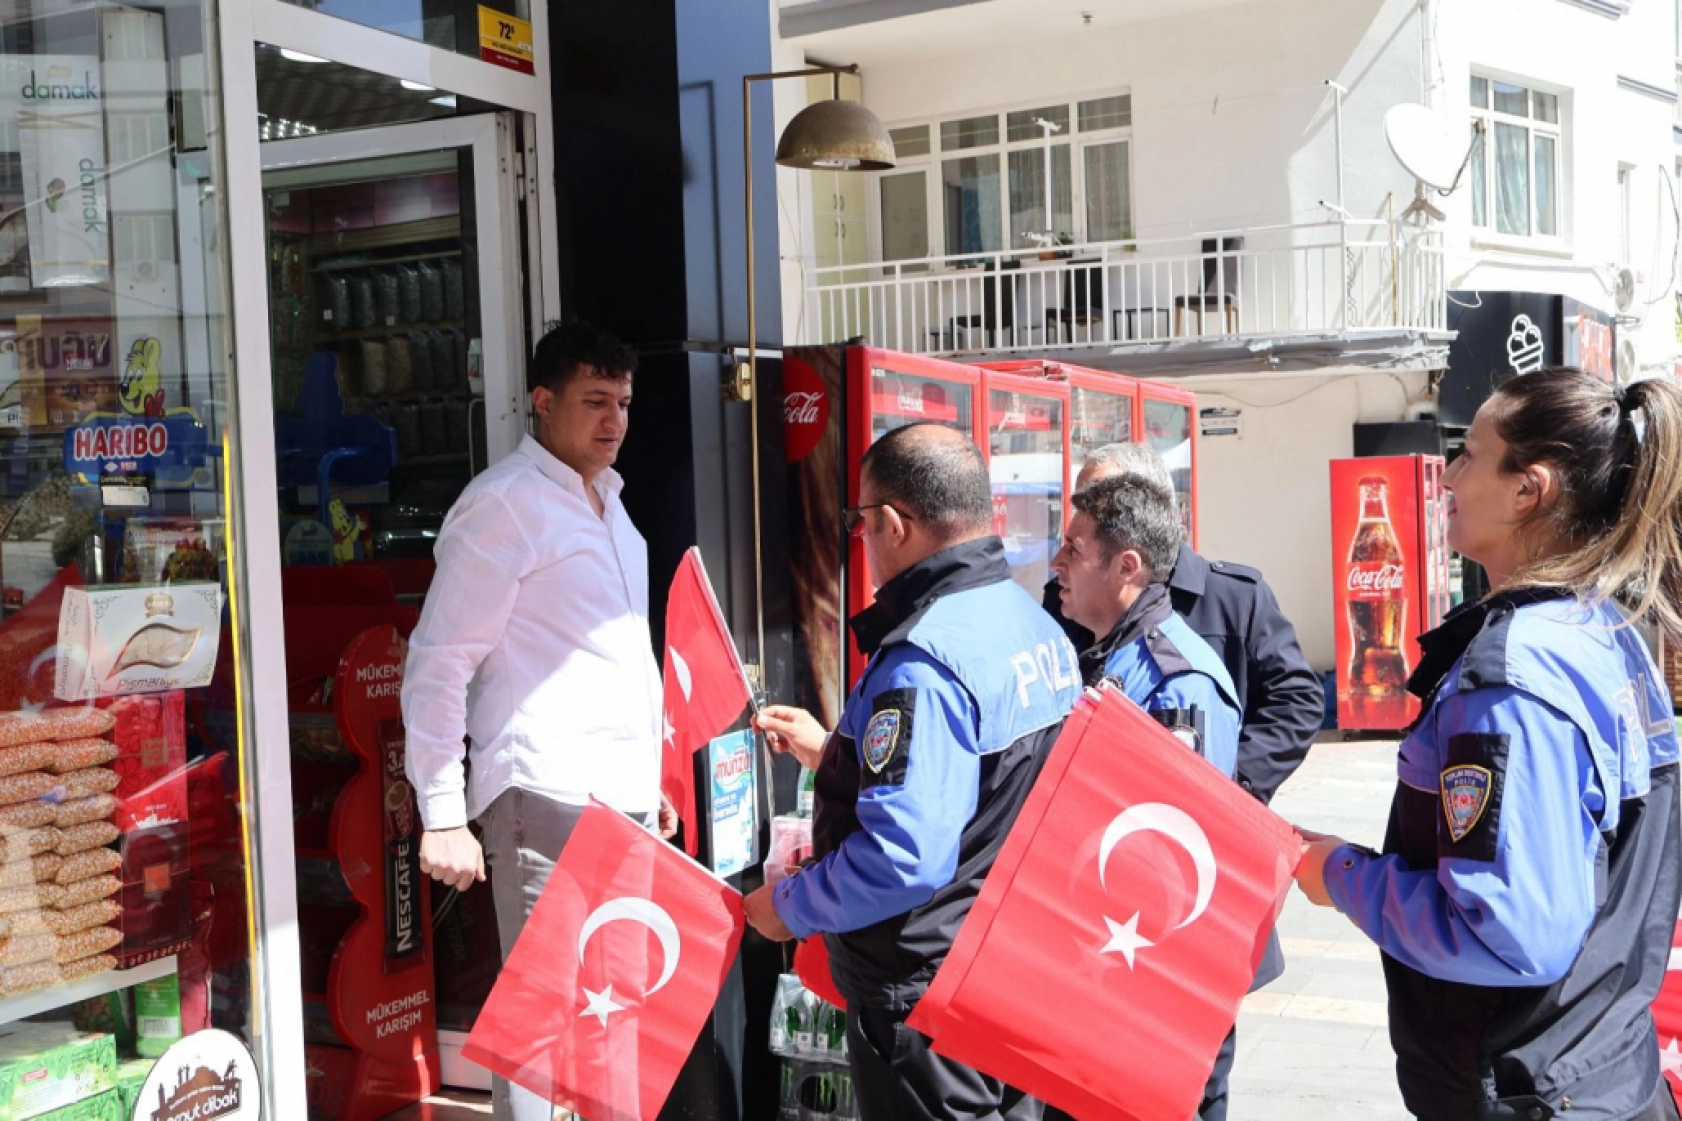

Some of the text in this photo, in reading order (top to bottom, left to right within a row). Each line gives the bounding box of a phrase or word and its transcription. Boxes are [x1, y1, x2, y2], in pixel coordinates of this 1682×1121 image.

[21, 70, 98, 99] damak
[78, 158, 101, 233] damak
[74, 422, 168, 461] HARIBO
[1347, 564, 1404, 591] Coca-Cola
[366, 989, 430, 1025] MÜKEMMEL
[376, 1009, 422, 1039] KARIŞIM
